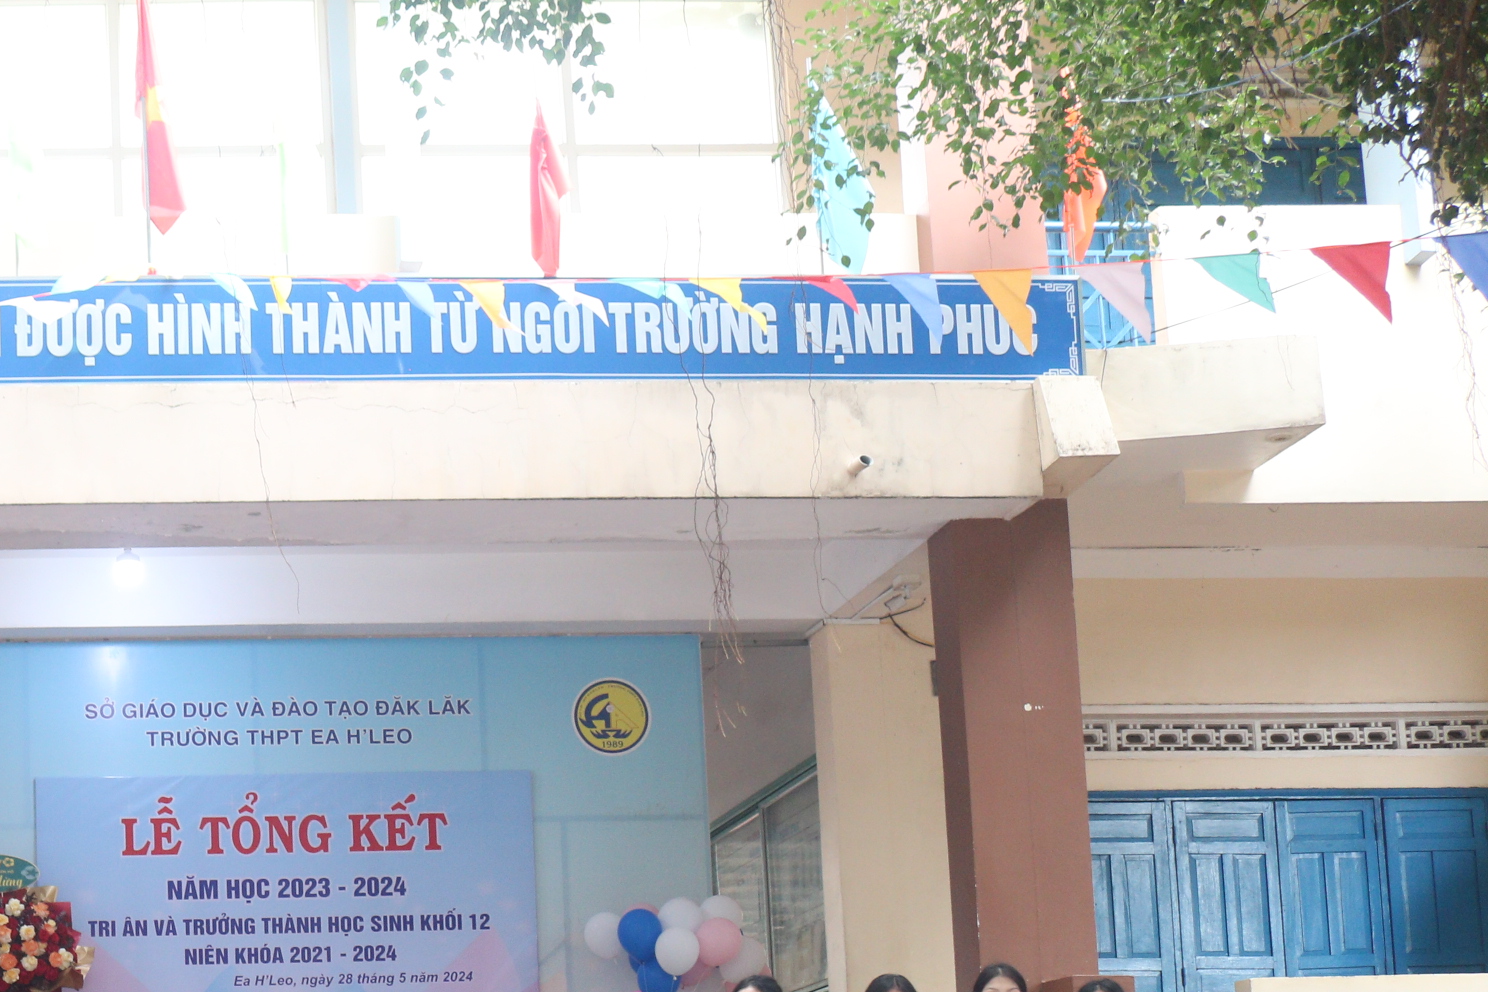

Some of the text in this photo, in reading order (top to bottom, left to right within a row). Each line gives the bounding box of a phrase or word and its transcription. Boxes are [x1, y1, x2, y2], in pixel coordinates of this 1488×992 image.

[14, 299, 132, 366] ĐƯỢC
[147, 293, 252, 355] HÌNH
[266, 291, 412, 354] THÀNH
[426, 291, 481, 354] TỪ
[608, 291, 778, 354] TRƯỜNG
[794, 303, 914, 364] HẠNH
[84, 695, 471, 721] SỞ GIÁO DỤC VÀ ĐÀO TẠO ĐĂK LĂK
[146, 727, 413, 747] TRƯỜNG THPT EA H'LEO
[121, 792, 448, 856] LỄ TỔNG KẾT
[167, 876, 218, 900] NĂM
[226, 878, 270, 904] HỌC
[277, 878, 331, 899] 2023
[353, 876, 407, 897] 2024
[88, 908, 491, 937] TRI ÂN VÀ TRƯỞNG THÀNH HỌC SINH KHỐI 12
[184, 944, 229, 965] NIÊN
[234, 943, 284, 965] KHÓA
[289, 946, 332, 963] 2021
[352, 945, 397, 962] 2024
[234, 971, 473, 988] Ea H'Leo, ngày 28 tháng 5 năm 2024
